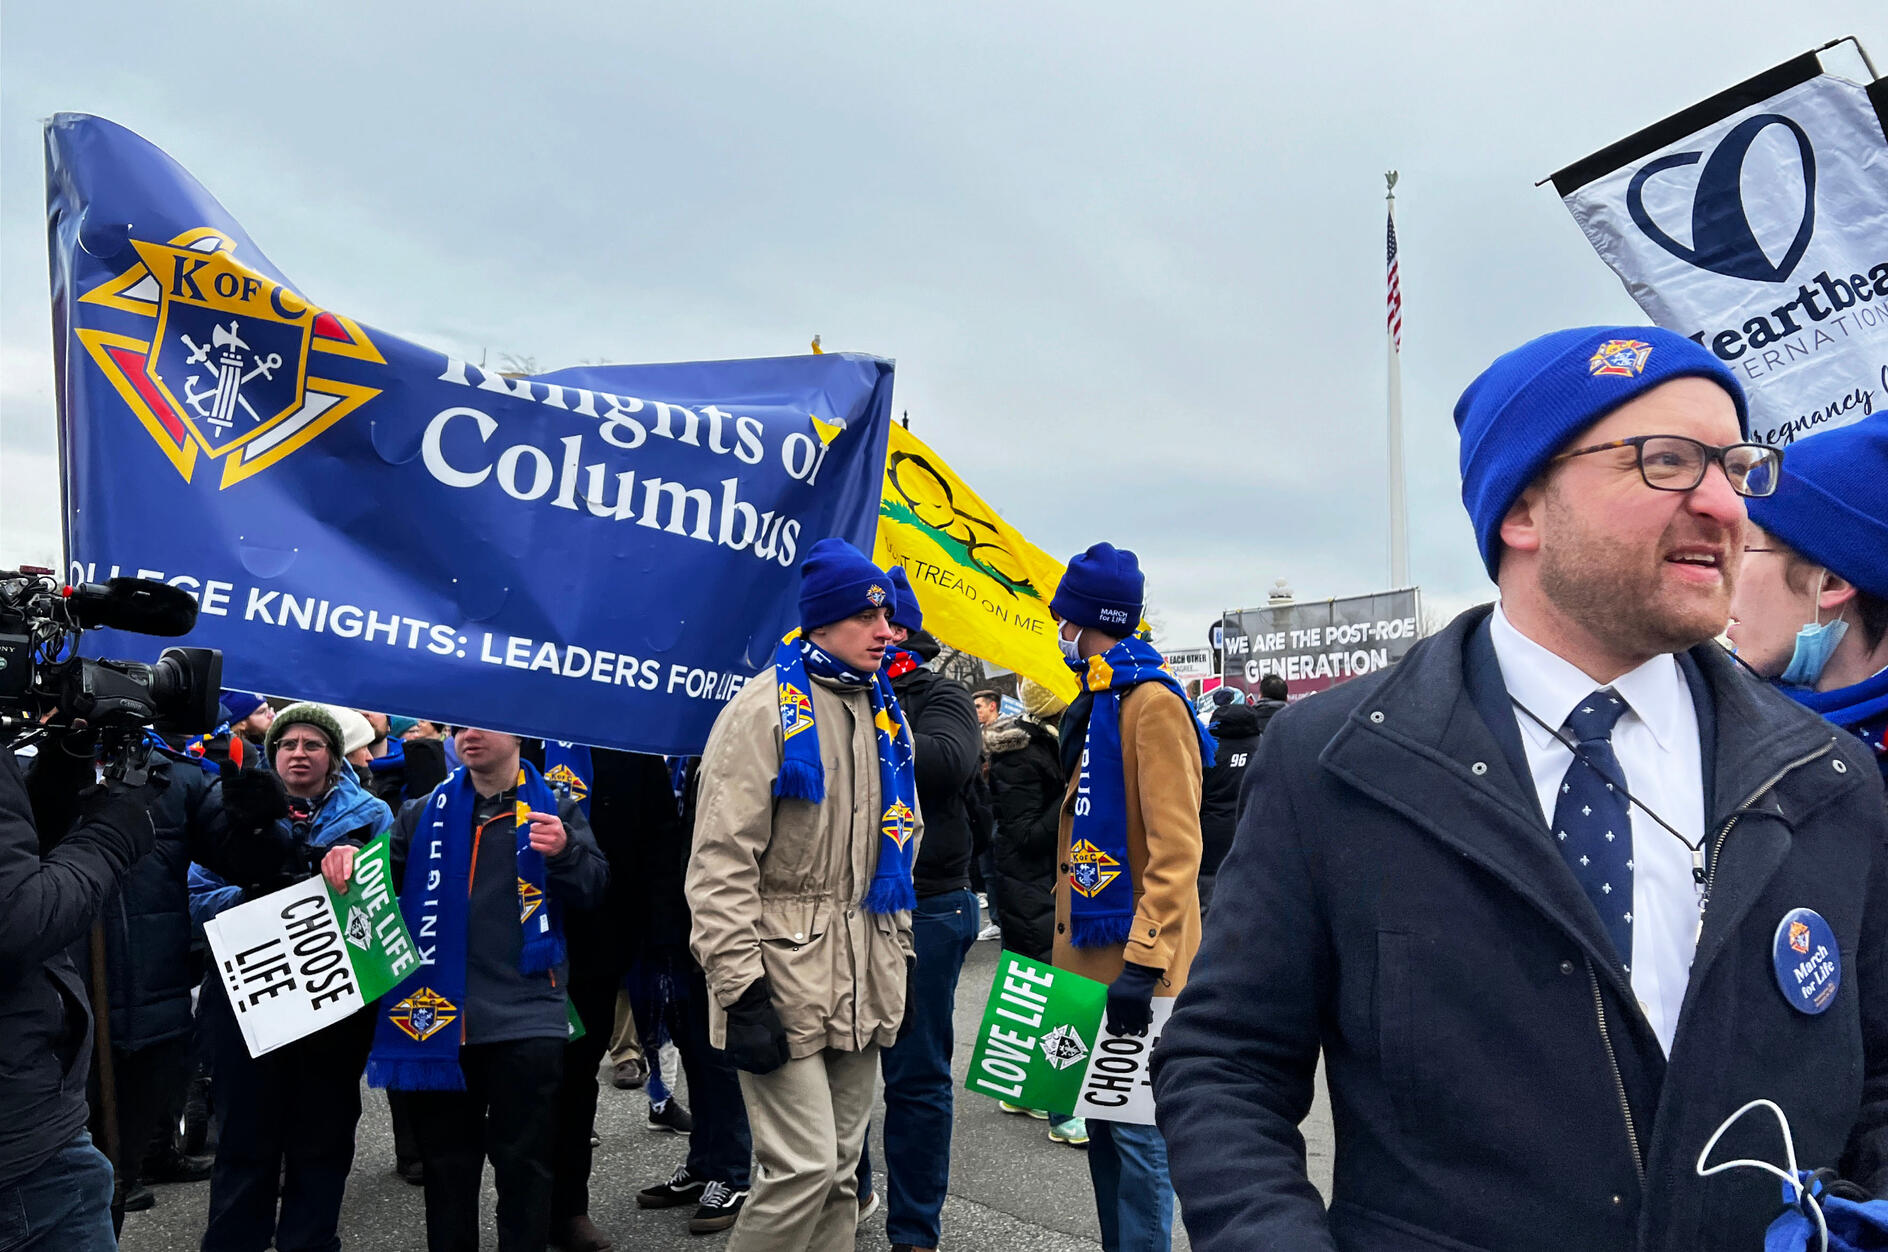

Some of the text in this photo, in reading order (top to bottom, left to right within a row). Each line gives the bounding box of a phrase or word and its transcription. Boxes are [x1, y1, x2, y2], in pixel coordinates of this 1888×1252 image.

[171, 255, 210, 300] K
[270, 284, 308, 319] C
[1730, 302, 1888, 380] ERNATION
[1751, 388, 1875, 446] regnancy
[421, 406, 801, 568] Columbus
[70, 560, 234, 617] OLGE
[245, 587, 468, 658] KNIGHTS:
[480, 632, 660, 691] LEADERS
[667, 664, 718, 699] FOR
[915, 560, 1045, 635] TREAD ON ME
[1100, 608, 1128, 618] MARCH
[1111, 615, 1127, 624] LIFE
[1169, 655, 1185, 664] EACH
[1187, 653, 1207, 663] OTHER
[1225, 635, 1249, 655] WE
[1253, 632, 1286, 653] ARE
[1290, 627, 1321, 648] THE
[1326, 617, 1415, 645] POST-ROE
[1245, 647, 1388, 684] GENERATION
[1230, 753, 1248, 767] 96
[354, 842, 415, 977] LOVE LIFE
[235, 938, 297, 1007] LIFE
[280, 895, 355, 1011] CHOOSE
[1793, 945, 1829, 984] March
[1801, 981, 1816, 999] for
[1814, 961, 1835, 985] Life
[976, 960, 1055, 1099] LOVE LIFE
[1084, 1035, 1145, 1107] CHOO
